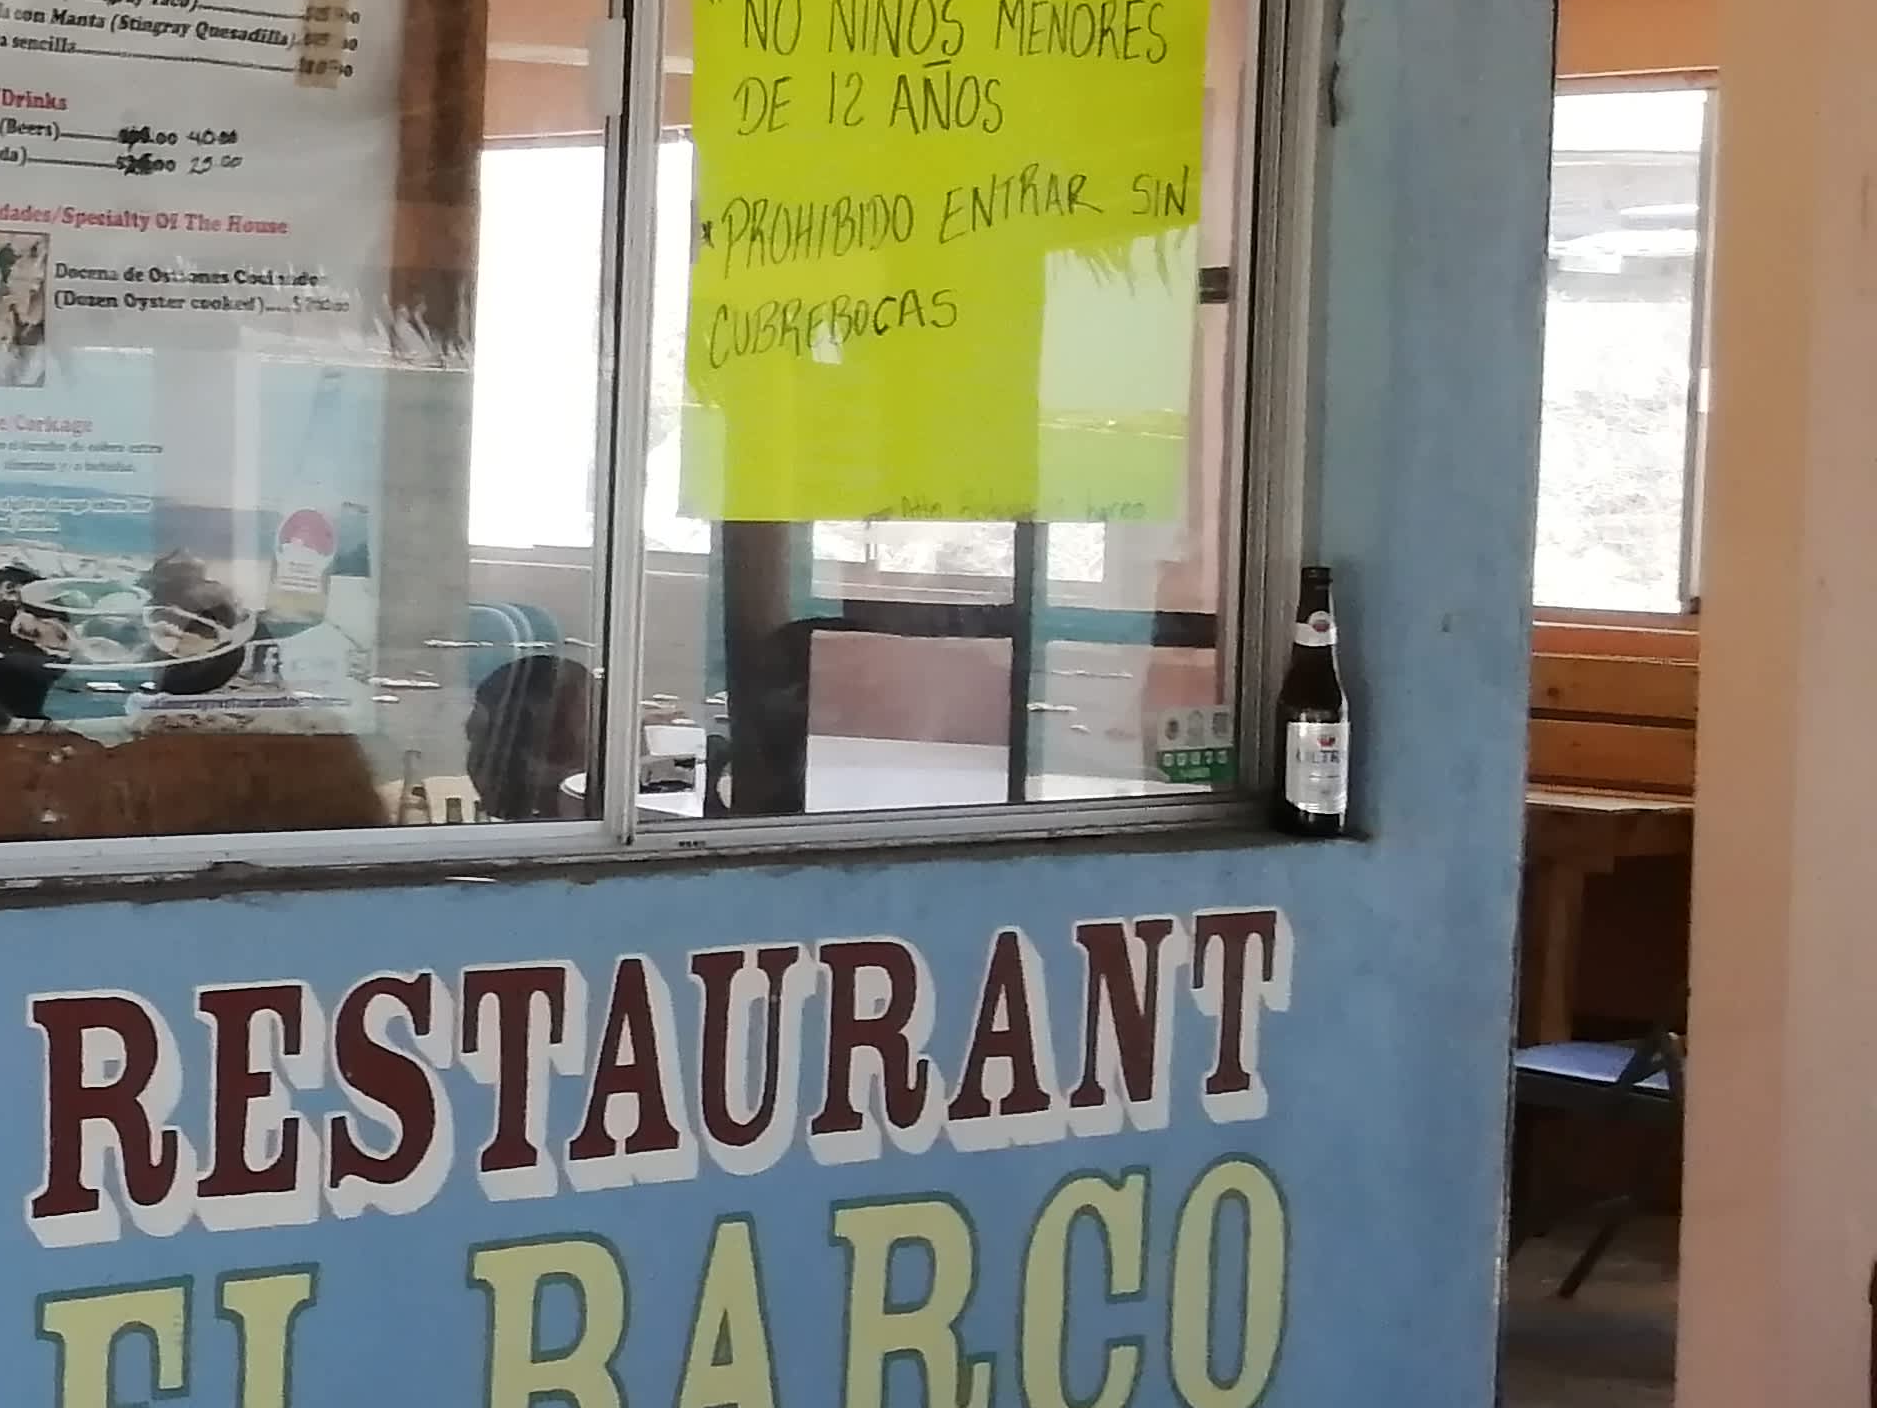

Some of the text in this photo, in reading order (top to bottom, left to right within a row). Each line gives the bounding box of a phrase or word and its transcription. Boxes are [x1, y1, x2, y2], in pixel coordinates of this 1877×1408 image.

[733, 60, 1004, 137] DE 12 AÑOS
[184, 213, 222, 232] The
[721, 162, 1189, 278] PROHIBIDO ENTRAR SIN
[123, 267, 144, 282] de
[708, 289, 958, 369] CUBREBOCAS
[27, 908, 1293, 1246] RESTAURANT
